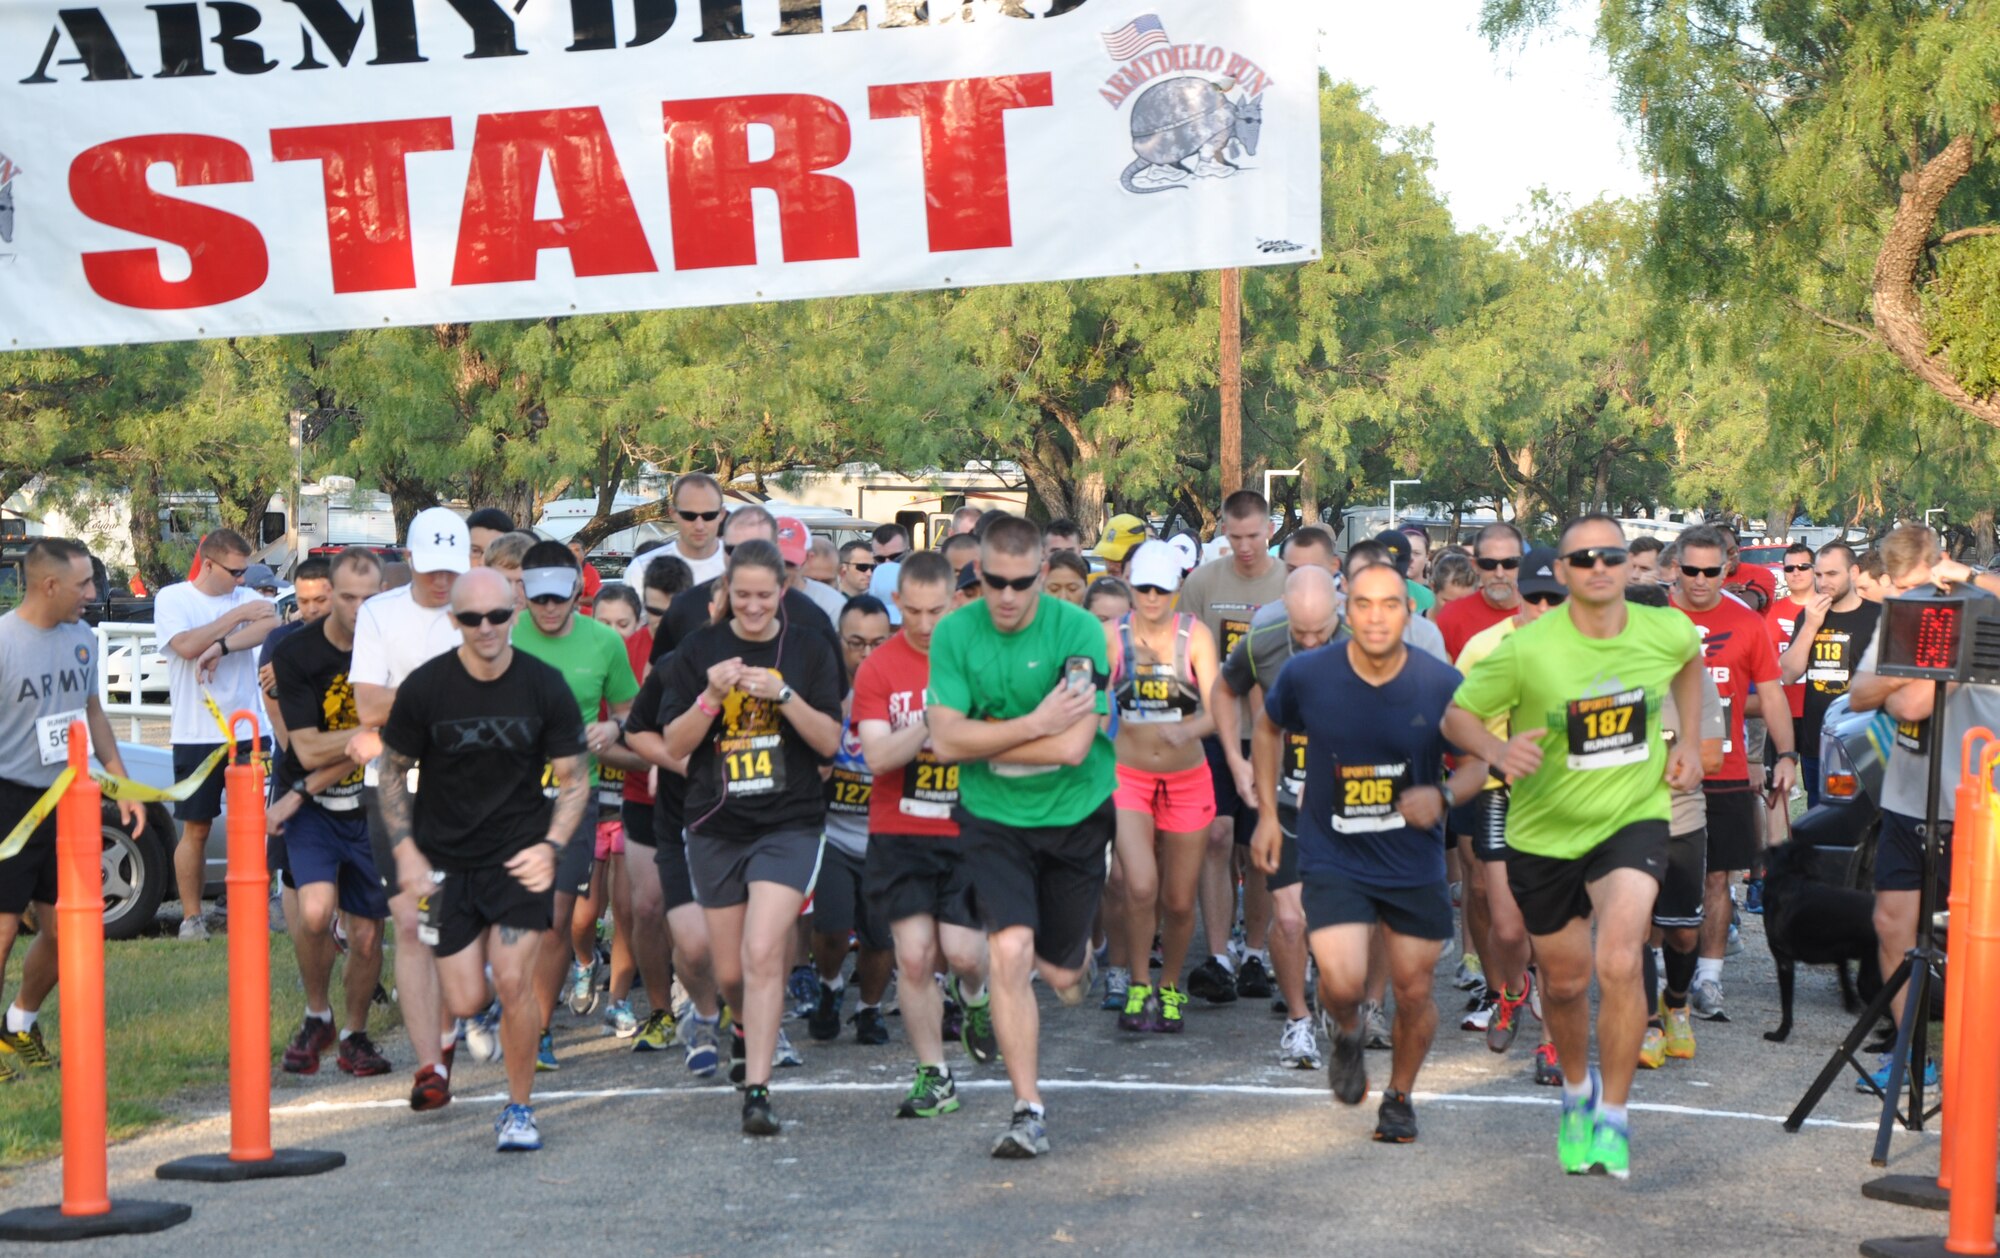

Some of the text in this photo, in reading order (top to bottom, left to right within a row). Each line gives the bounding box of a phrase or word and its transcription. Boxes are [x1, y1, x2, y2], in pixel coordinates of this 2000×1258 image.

[1098, 44, 1274, 110] ARMYDILLO RUN
[69, 73, 1053, 310] START
[1815, 643, 1841, 660] 113
[17, 668, 90, 702] ARMY
[1584, 706, 1633, 739] 187
[726, 750, 772, 780] 114
[835, 781, 872, 804] 127
[1344, 779, 1392, 805] 205
